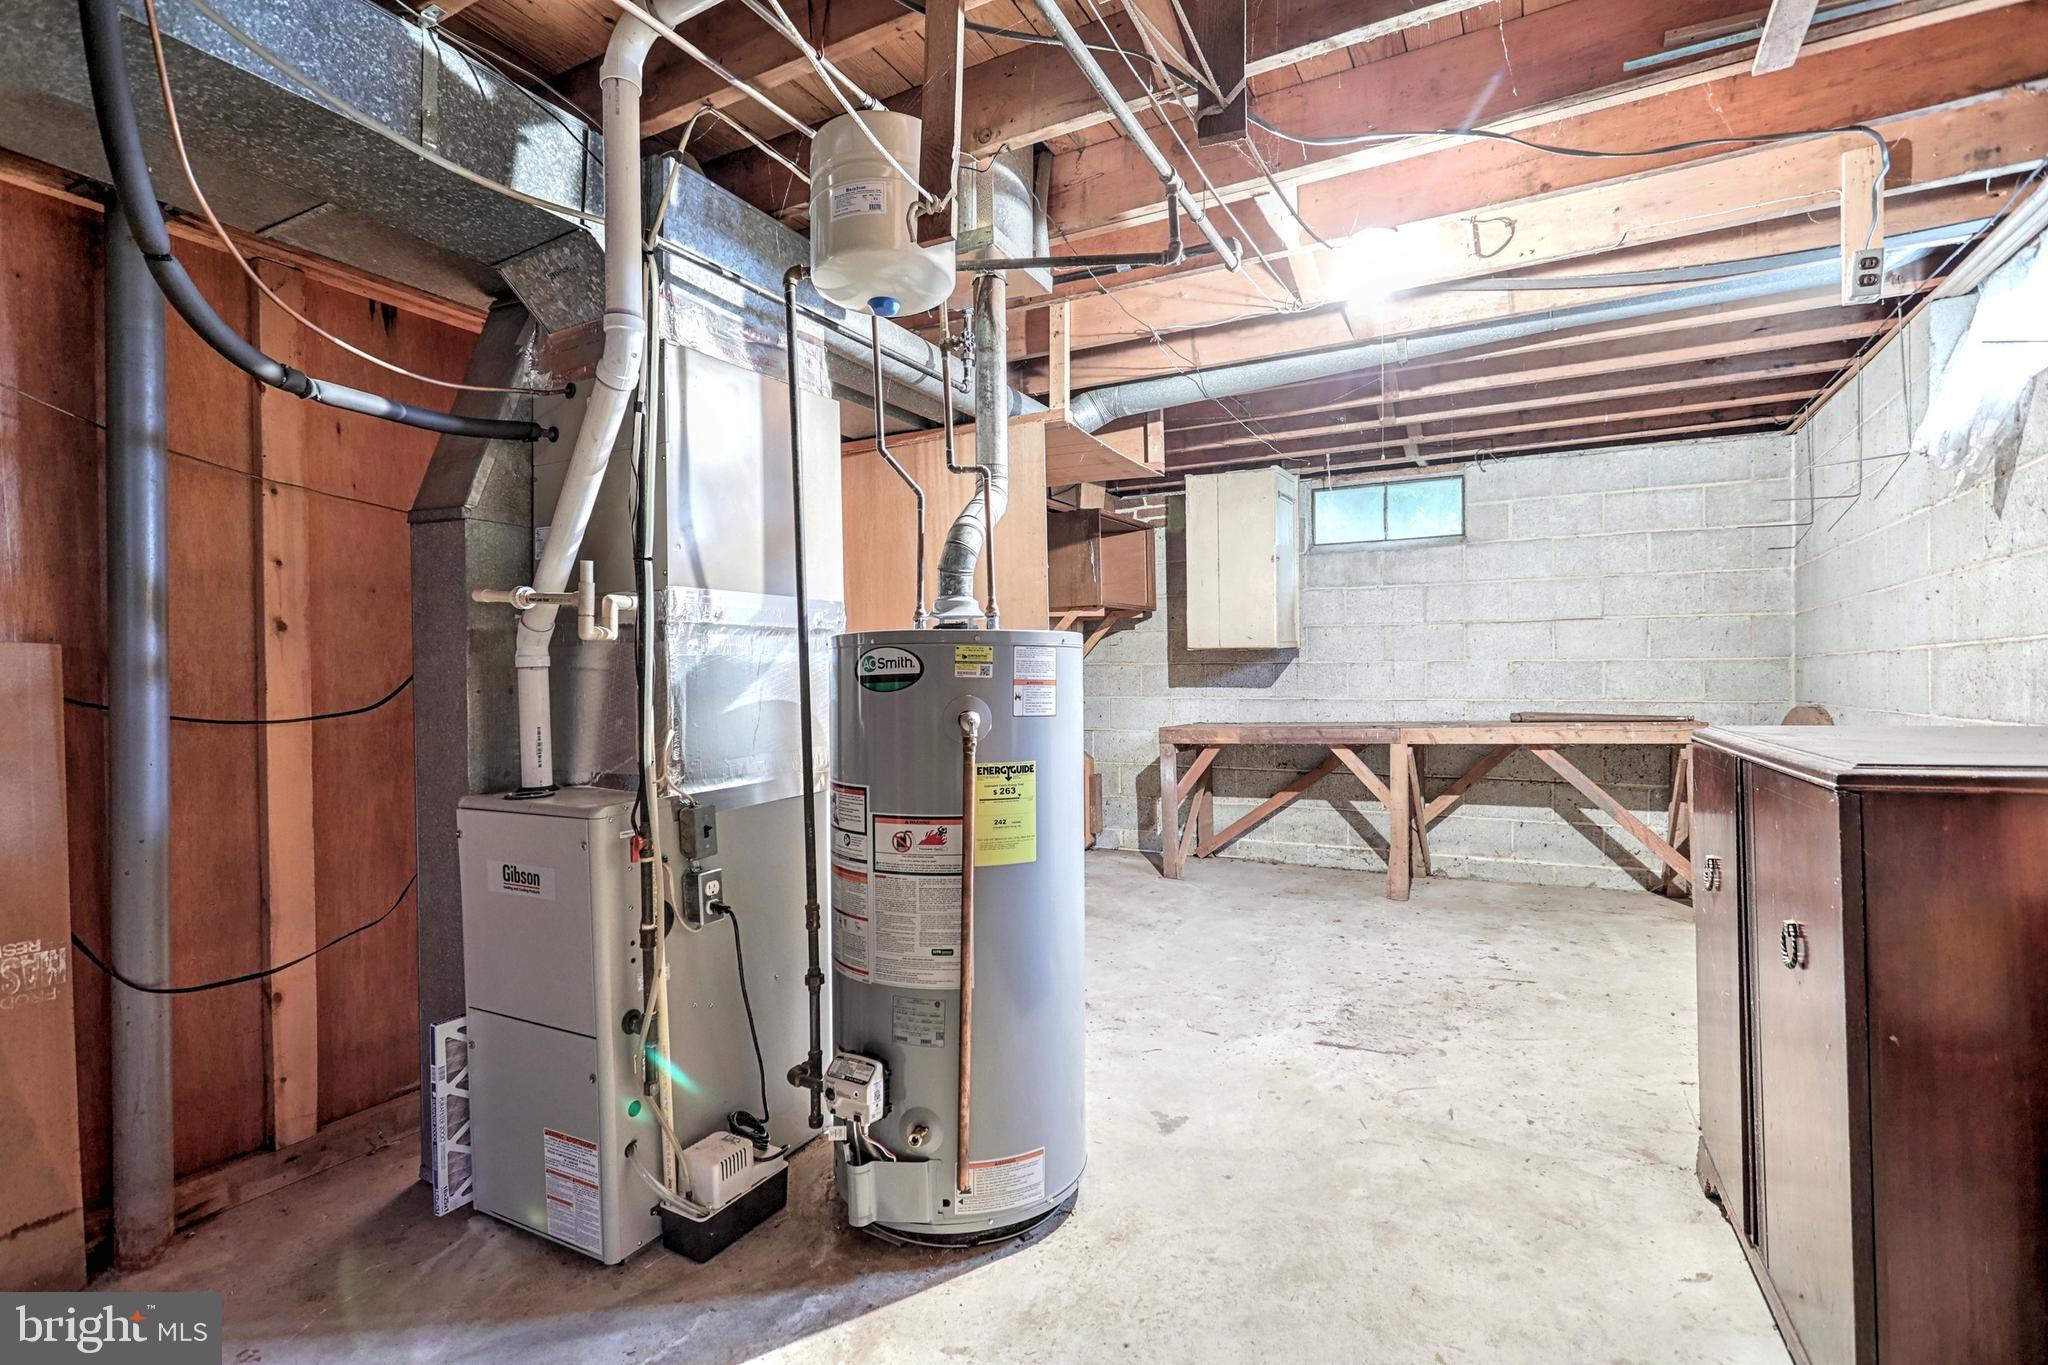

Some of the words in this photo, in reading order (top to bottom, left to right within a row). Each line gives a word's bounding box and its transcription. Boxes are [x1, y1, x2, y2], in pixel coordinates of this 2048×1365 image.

[877, 657, 913, 669] Smith
[1000, 786, 1016, 795] 263
[502, 864, 540, 886] Gibson
